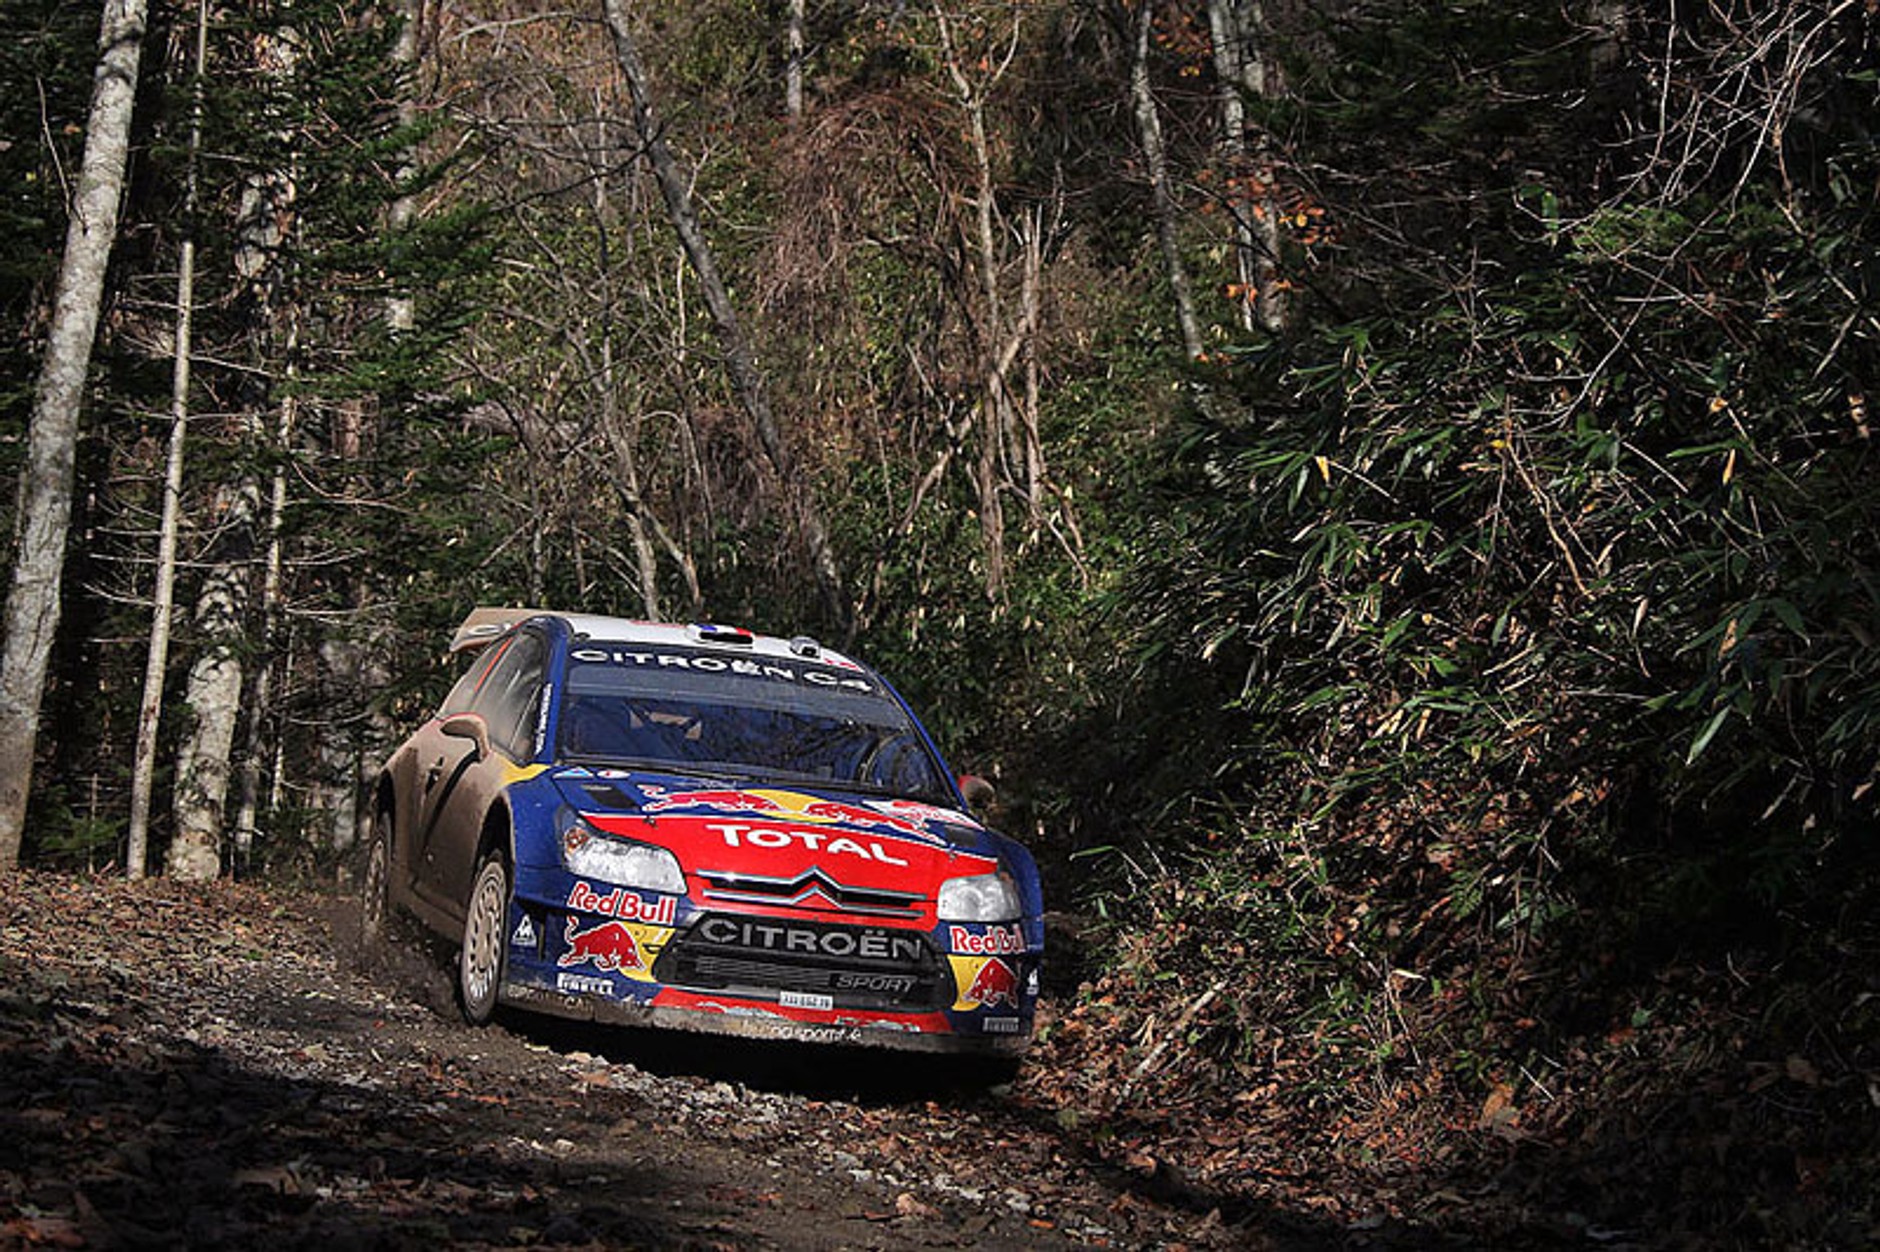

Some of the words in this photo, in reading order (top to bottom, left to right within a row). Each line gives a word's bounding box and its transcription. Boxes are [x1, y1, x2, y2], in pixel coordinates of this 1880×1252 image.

[571, 649, 794, 680] CITROËN
[705, 824, 908, 866] TOTAL
[567, 881, 621, 916] Red
[617, 892, 677, 926] Bull
[700, 918, 922, 959] CITROËN
[836, 974, 917, 993] SPORT
